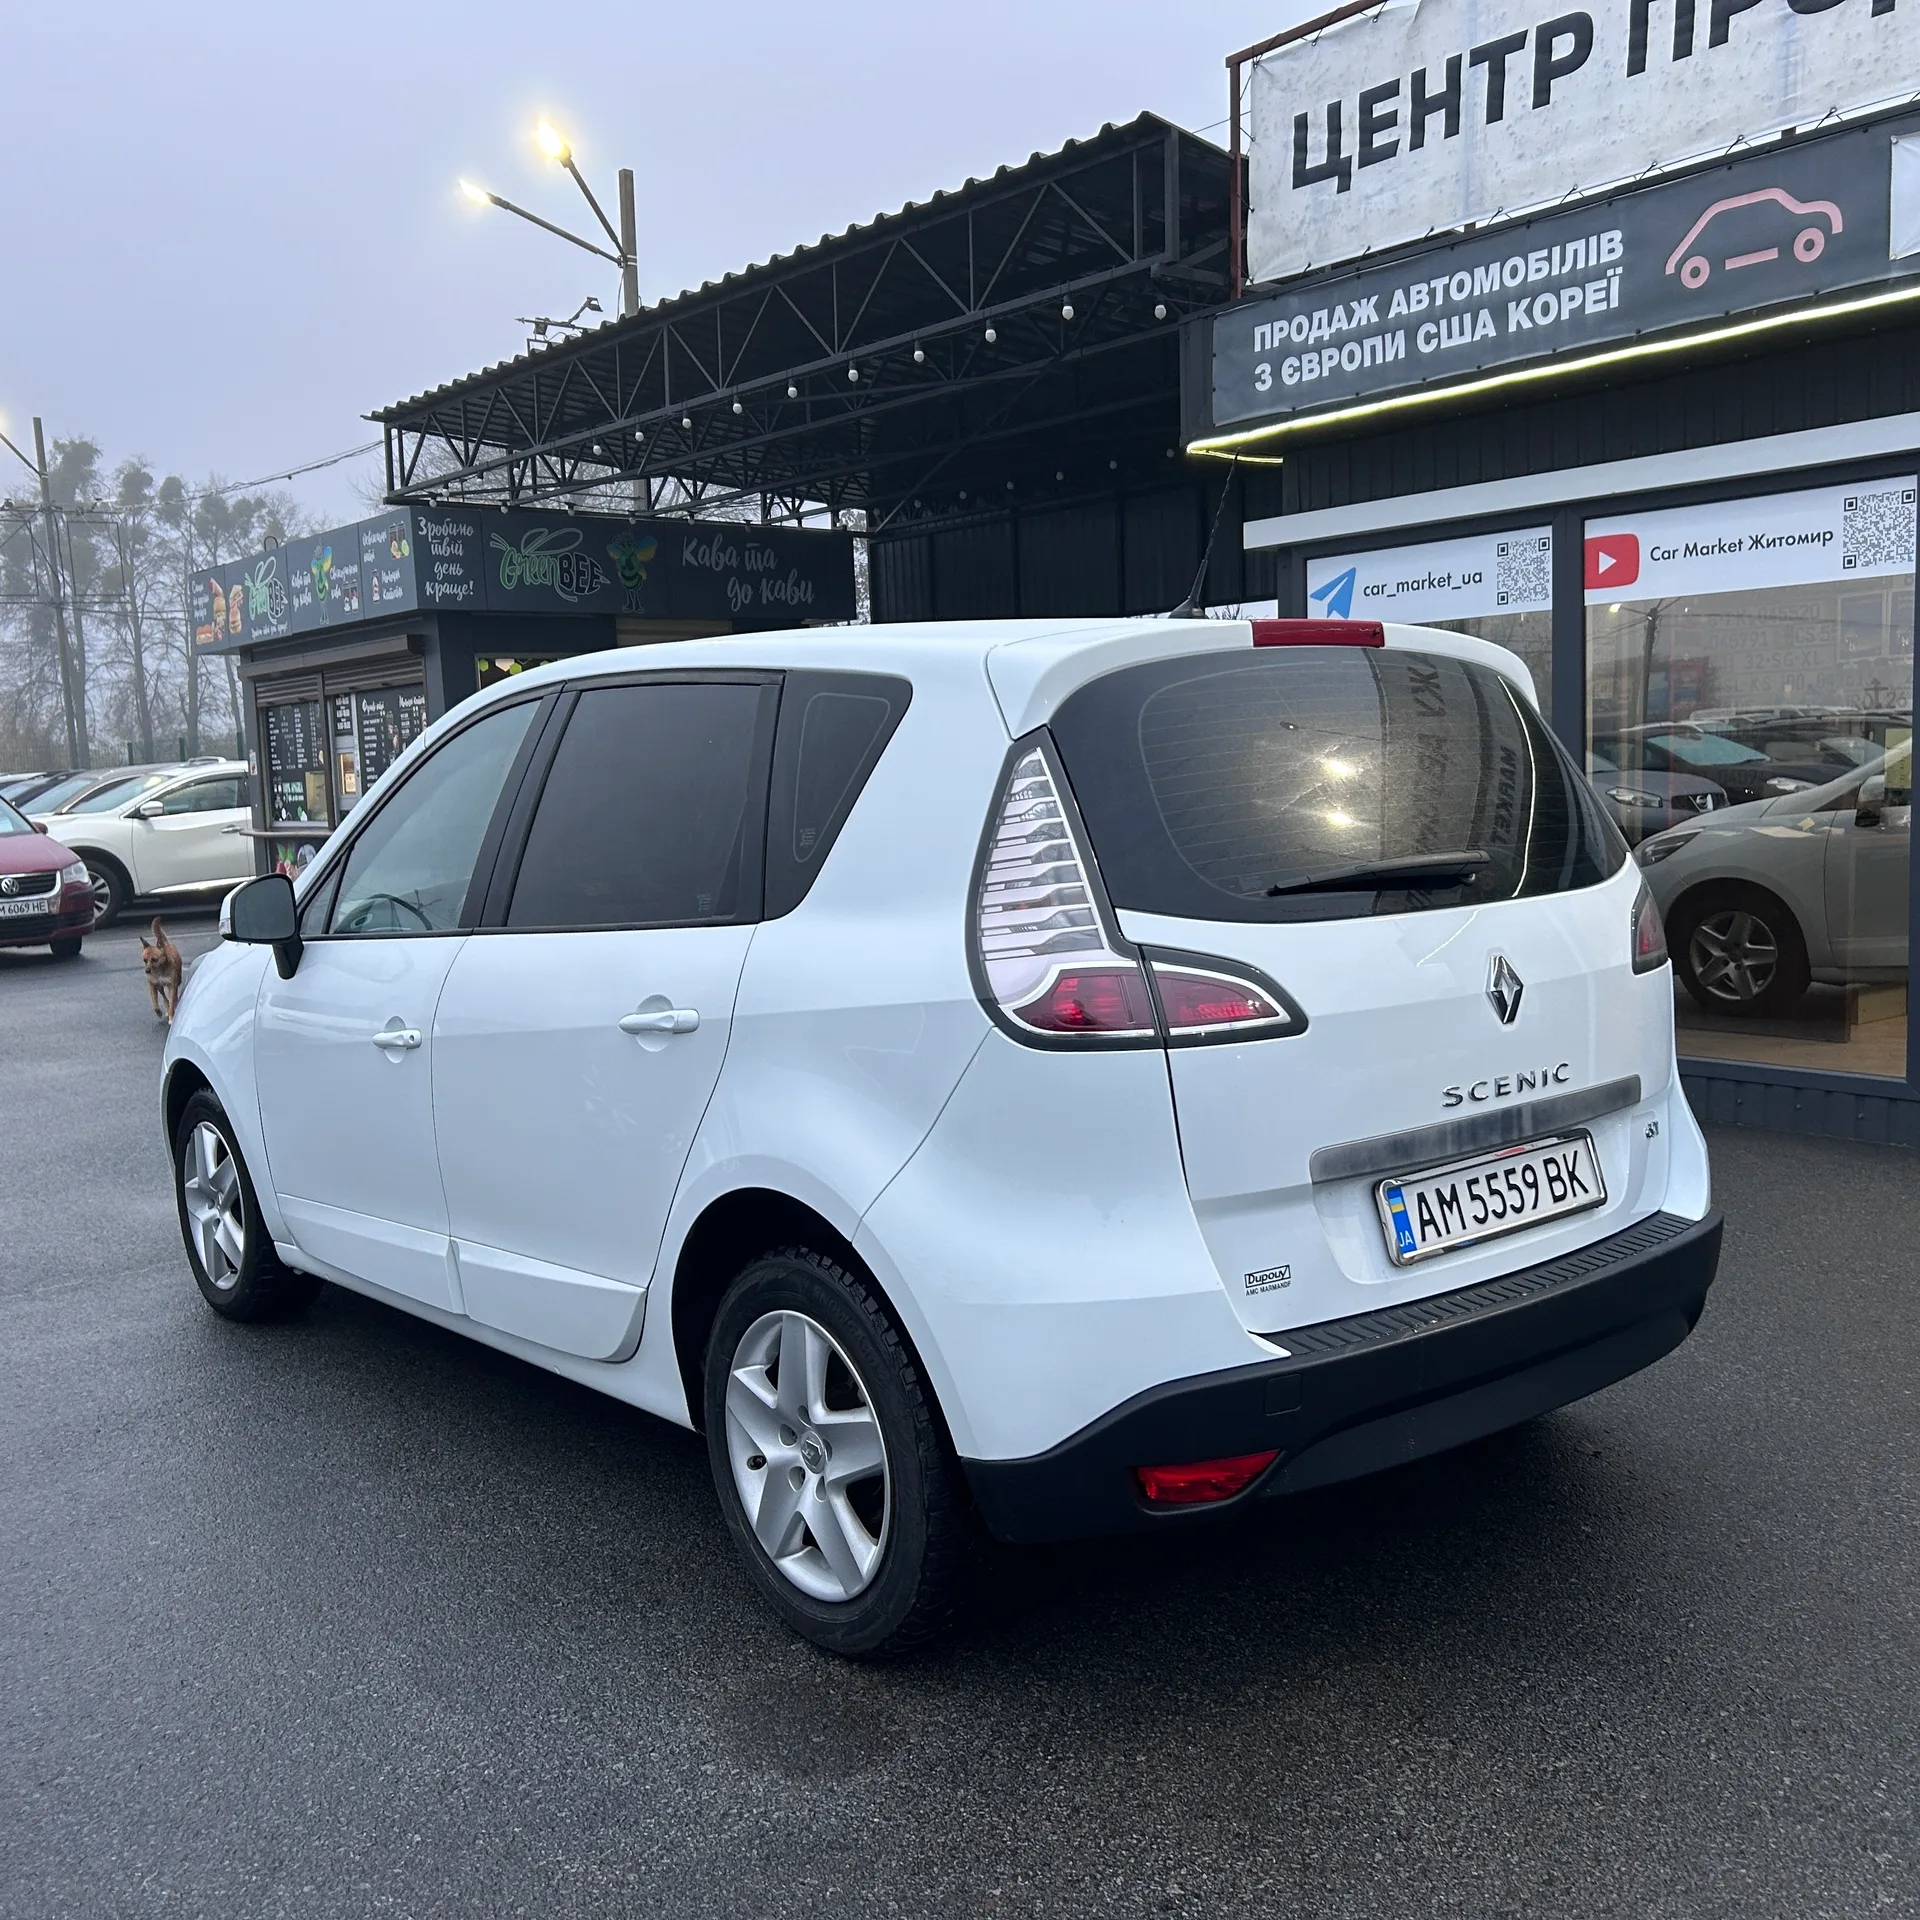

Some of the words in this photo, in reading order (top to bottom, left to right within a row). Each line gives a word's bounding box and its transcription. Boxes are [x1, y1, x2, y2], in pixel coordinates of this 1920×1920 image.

[1292, 12, 1594, 194] ЦЕНТР
[1254, 295, 1379, 352] ПРОДАЖ
[1388, 229, 1624, 319] АВТОМОБІЛІВ
[1255, 362, 1273, 392] З
[1281, 329, 1405, 386] ЄВРОПИ
[1416, 308, 1496, 354] США
[1508, 267, 1624, 333] КОРЕЇ
[418, 516, 474, 542] Зробимо
[431, 538, 464, 557] твій
[682, 533, 740, 571] Кава
[744, 543, 778, 572] та
[1650, 546, 1678, 562] Car
[1683, 538, 1743, 558] Market
[1748, 530, 1834, 550] Житомир
[434, 561, 464, 581] день
[1363, 571, 1483, 598] car_market_ua
[425, 580, 474, 602] краще!
[727, 576, 754, 612] до
[759, 568, 815, 605] кави
[8, 902, 30, 914] 6069
[31, 900, 46, 912] HE
[1442, 1062, 1570, 1107] SCENIC
[1415, 1183, 1467, 1242] AM
[1466, 1163, 1539, 1225] 5559
[1543, 1150, 1589, 1204] BK
[1248, 1266, 1288, 1285] Dupouy
